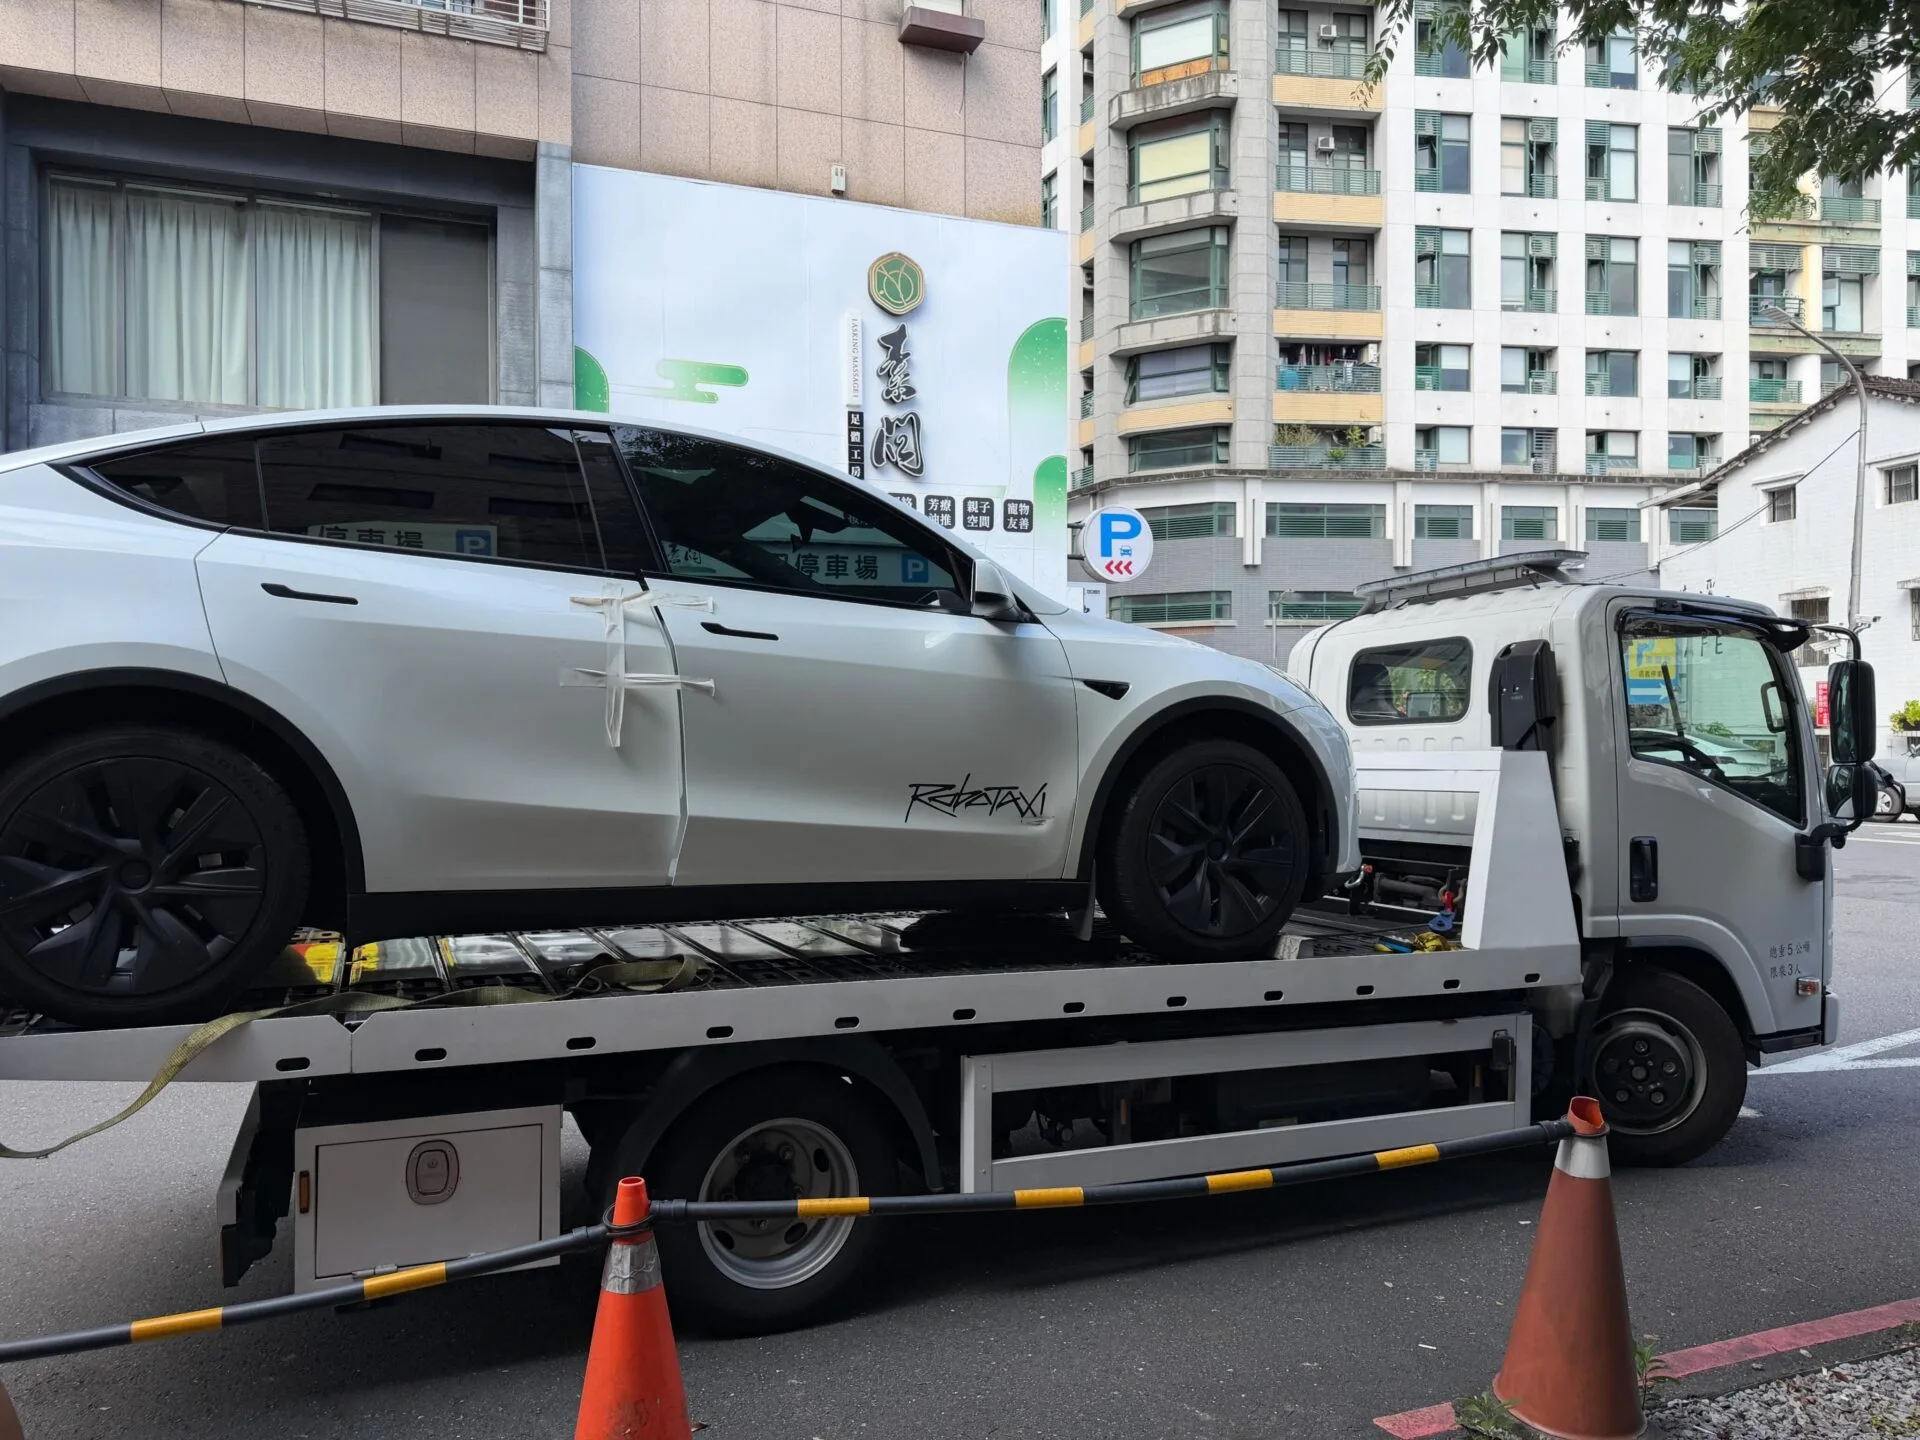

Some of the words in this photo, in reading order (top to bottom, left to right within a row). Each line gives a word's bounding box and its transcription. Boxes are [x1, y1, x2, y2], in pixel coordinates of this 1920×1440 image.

[966, 500, 991, 514] 親子
[1007, 502, 1030, 516] 寵物
[966, 515, 991, 529] 空間
[1007, 516, 1030, 530] 友善
[1100, 514, 1142, 558] P
[907, 559, 924, 580] P
